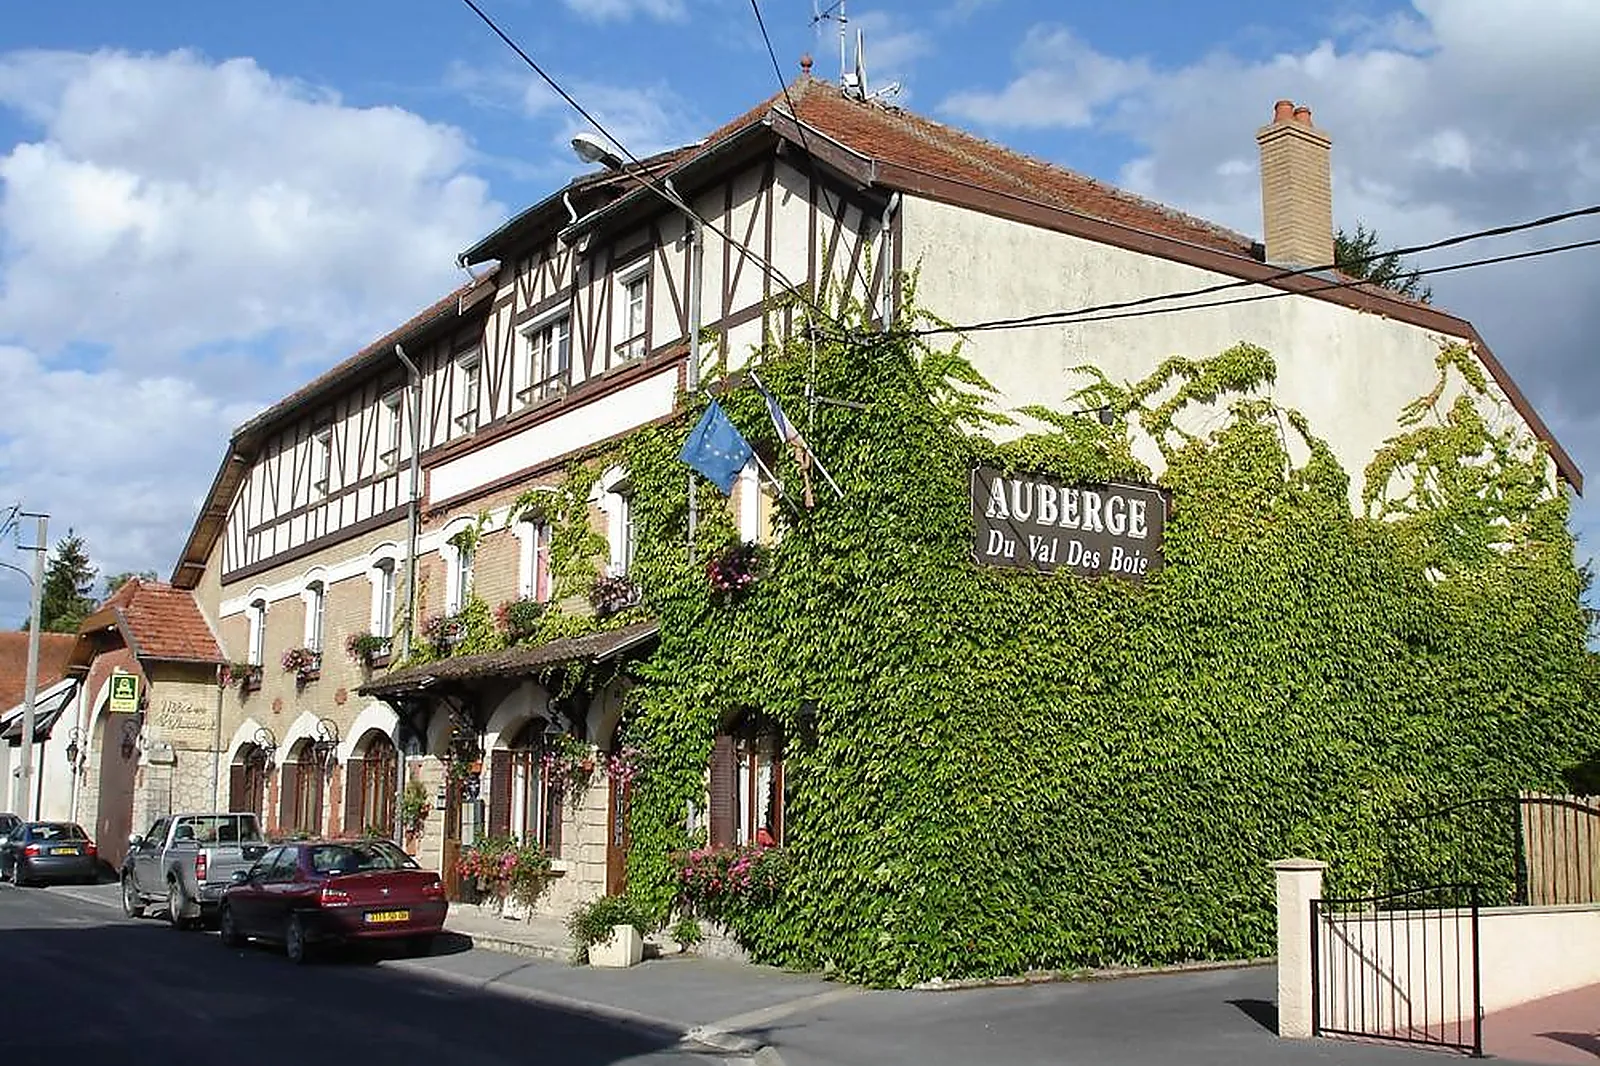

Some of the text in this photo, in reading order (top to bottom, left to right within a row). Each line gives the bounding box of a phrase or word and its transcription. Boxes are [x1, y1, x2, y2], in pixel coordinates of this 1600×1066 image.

[985, 477, 1148, 539] AUBERGE
[986, 529, 1149, 575] Du Val Des Bois
